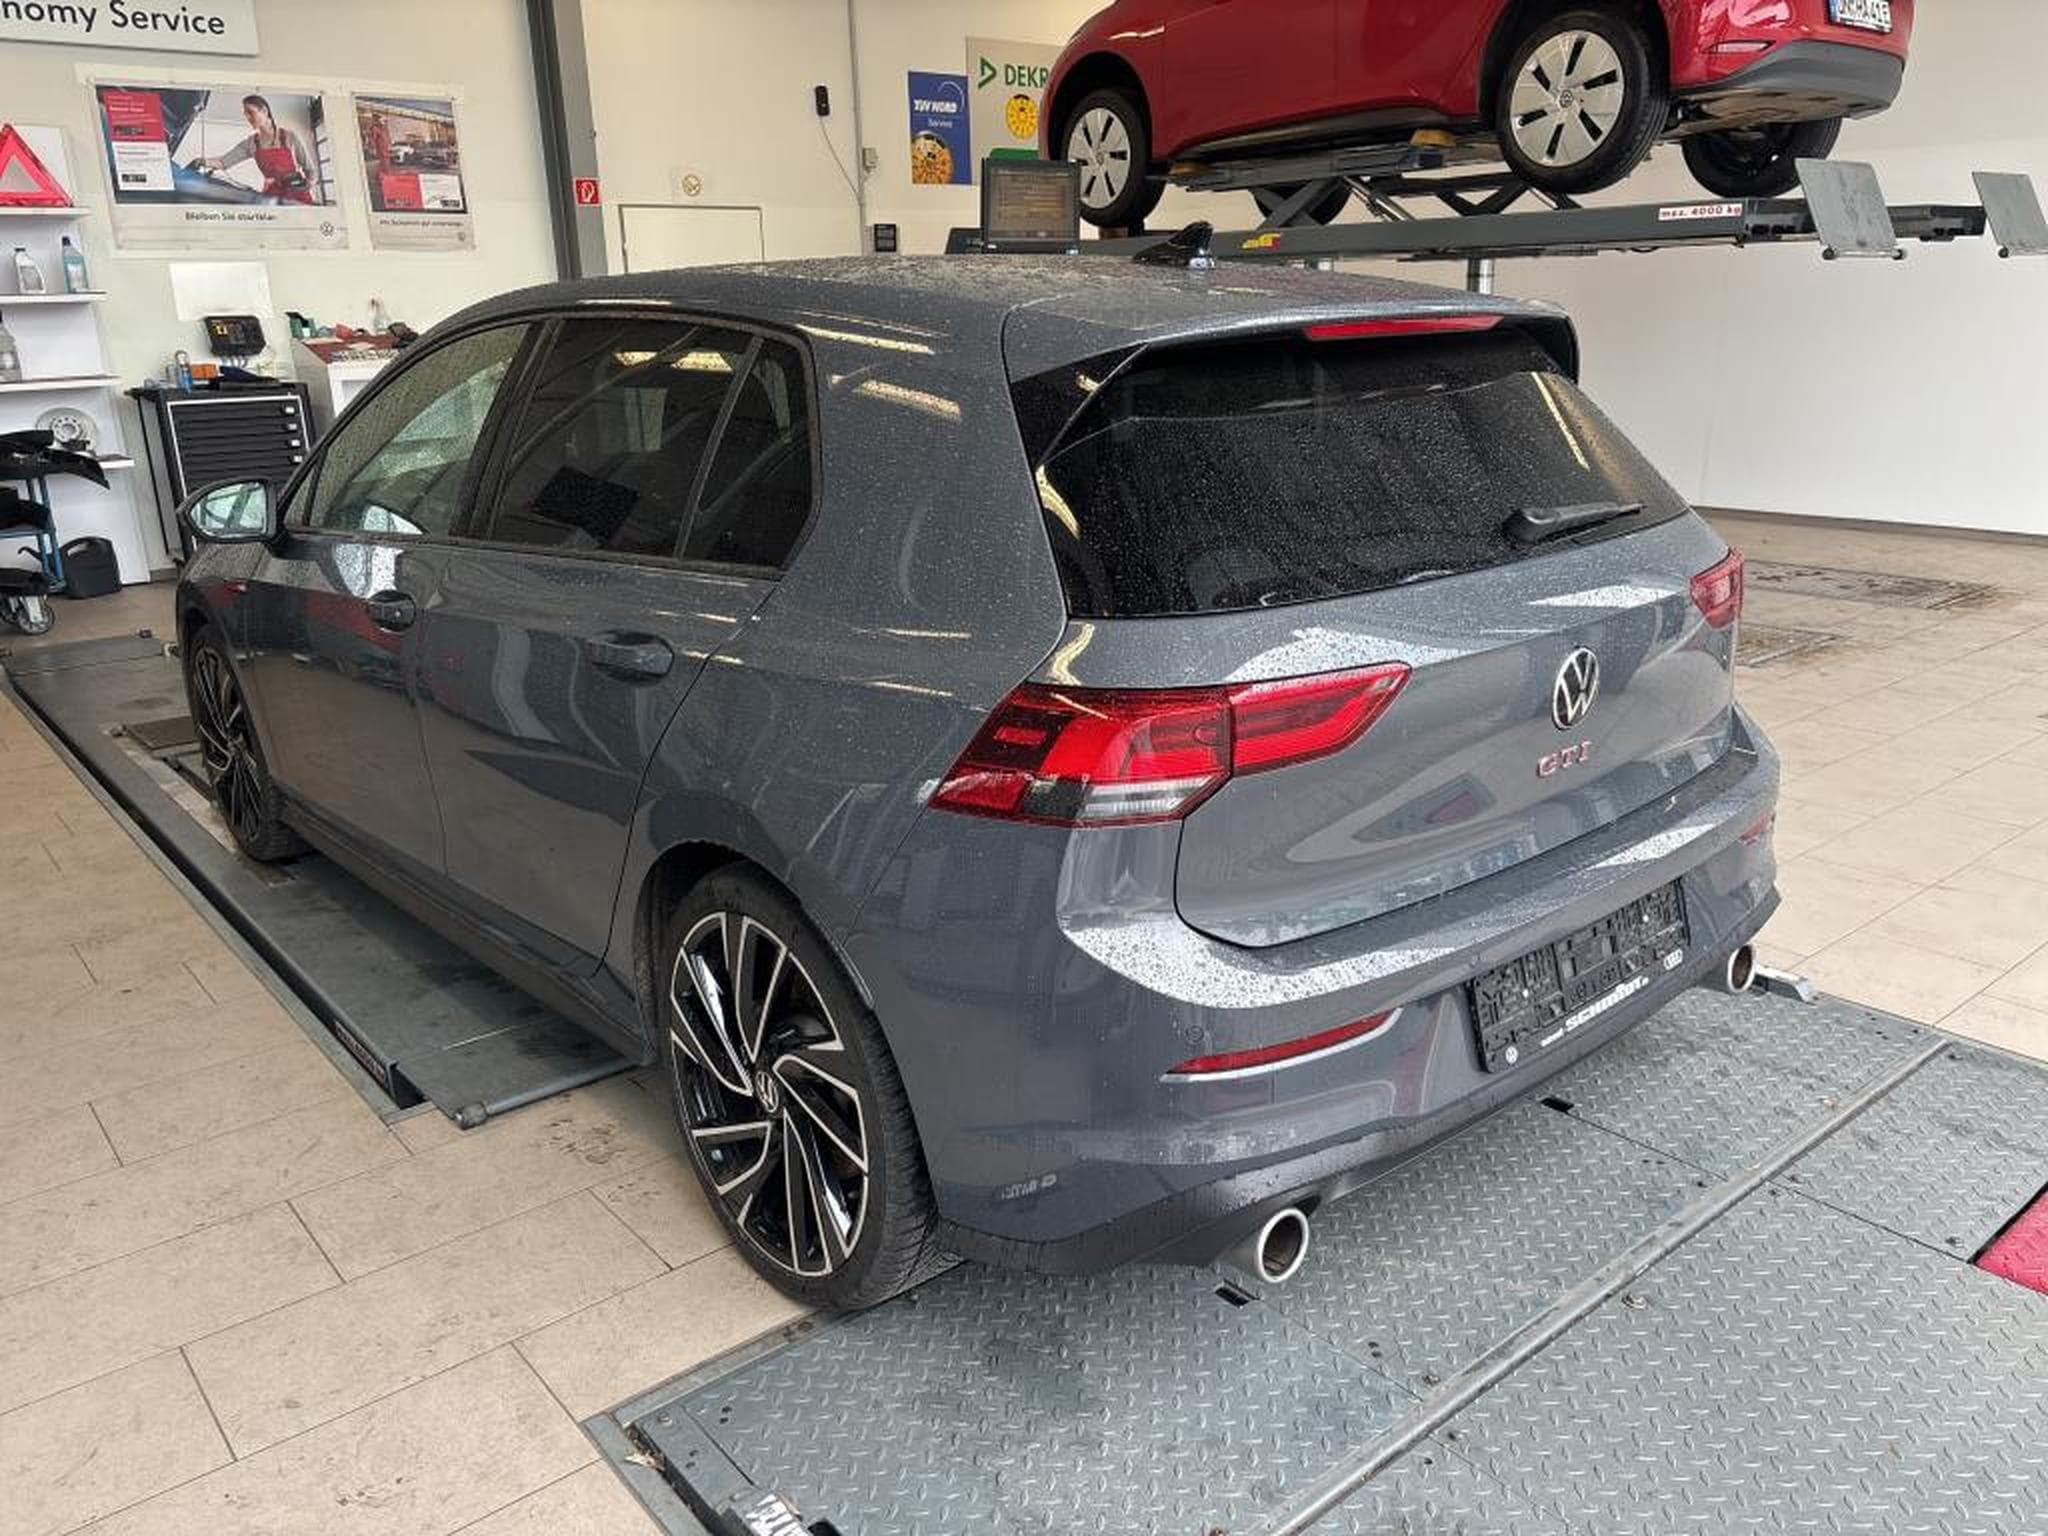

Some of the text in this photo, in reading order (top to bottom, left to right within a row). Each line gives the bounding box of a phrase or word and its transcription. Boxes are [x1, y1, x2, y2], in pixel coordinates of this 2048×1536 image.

[109, 0, 226, 35] Service
[1691, 206, 1723, 216] 4000
[1537, 739, 1592, 778] GTI
